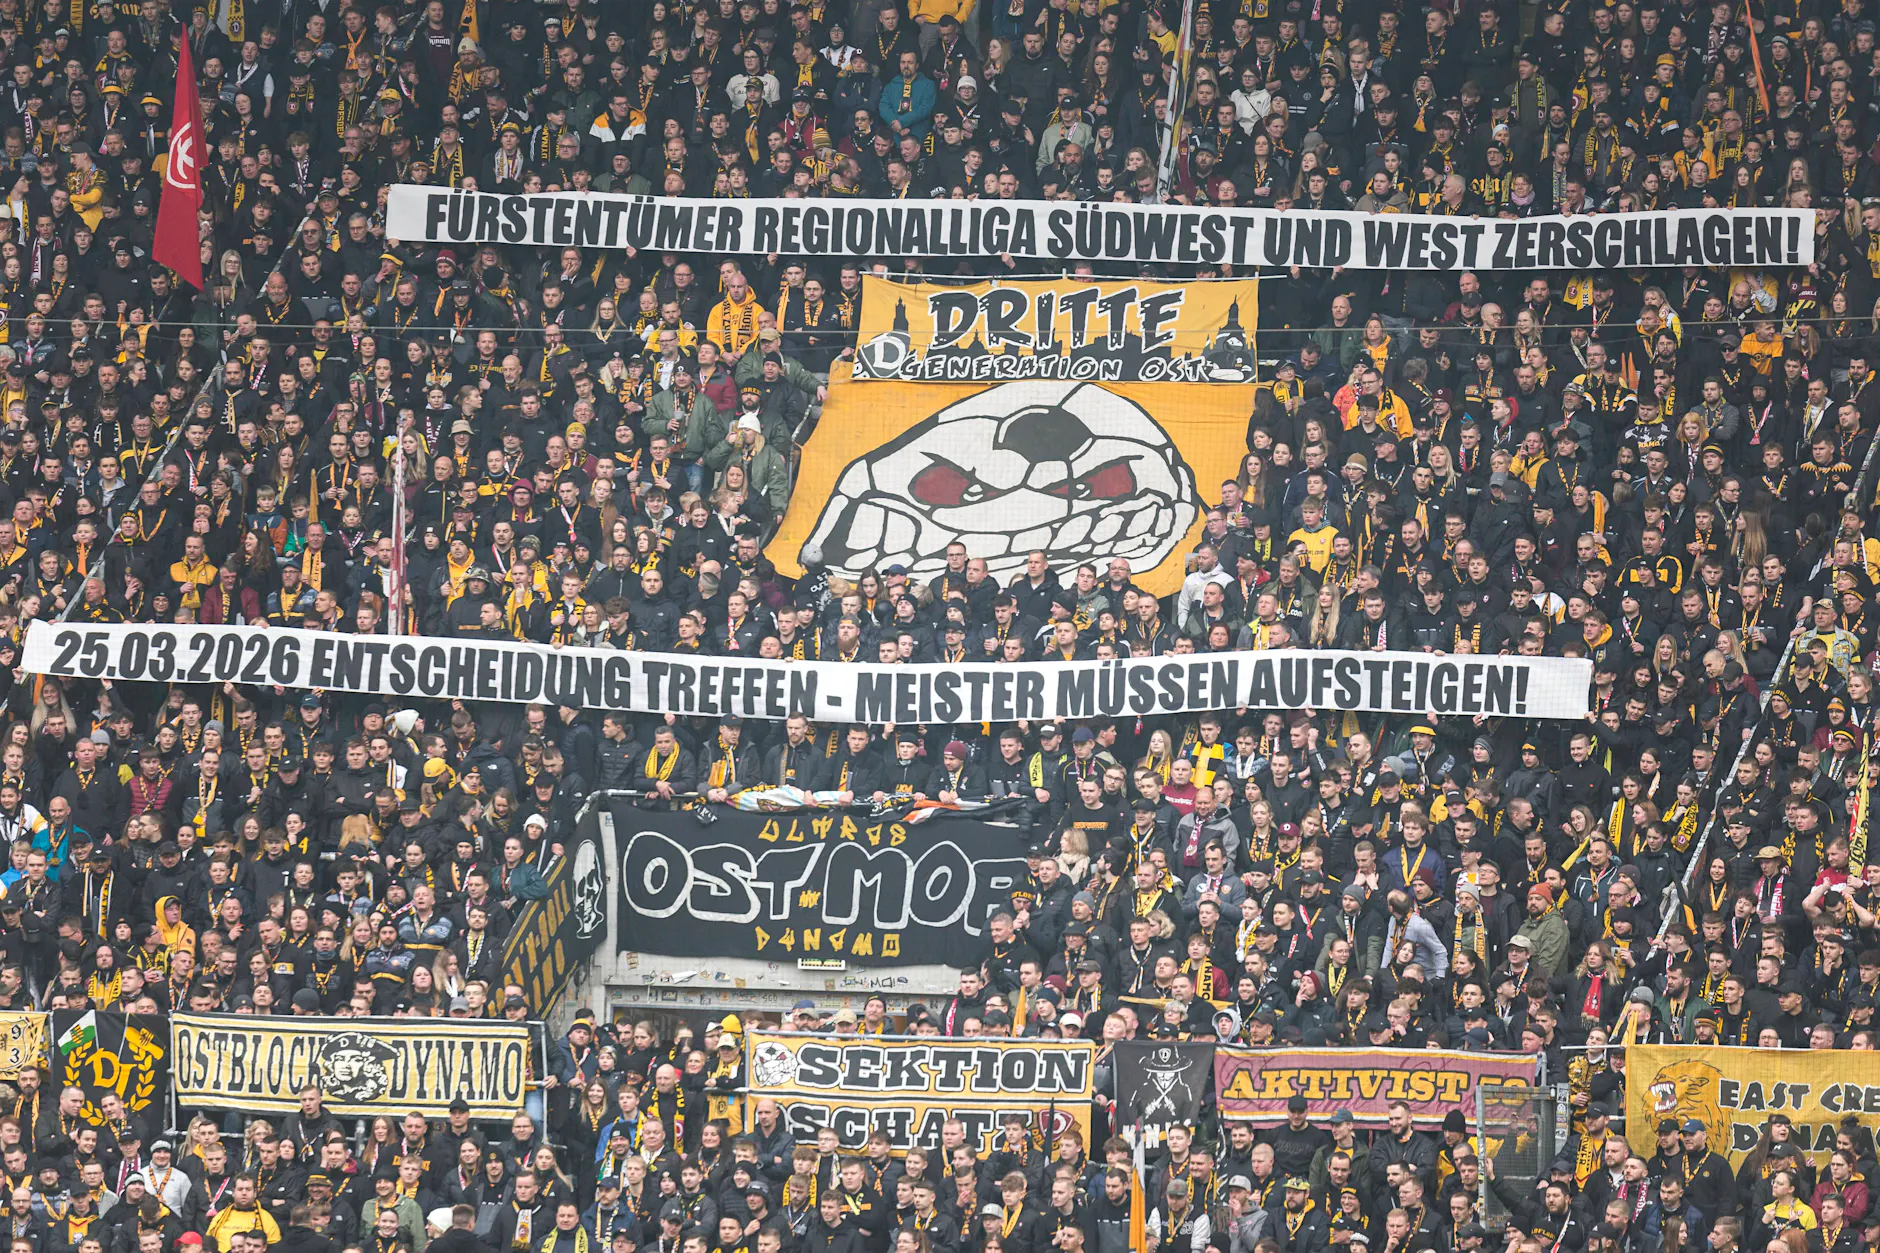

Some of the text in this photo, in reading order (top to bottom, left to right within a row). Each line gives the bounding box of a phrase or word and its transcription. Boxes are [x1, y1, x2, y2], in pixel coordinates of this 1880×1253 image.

[426, 189, 1801, 270] FÜRSTENTÜMER REGIONALLIGA SÜDWEST UND WEST ZERSCHLAGEN!
[928, 286, 1185, 354] DRITTE
[899, 354, 1210, 383] GENERATION OST
[49, 630, 300, 685] 25.03.2026
[308, 638, 631, 709] ENTSCHEIDUNG
[643, 660, 818, 720] TREFFEN
[855, 671, 1044, 723] MEISTER
[1057, 658, 1239, 717] MÜSSEN
[1248, 657, 1530, 715] AUFSTEIGEN!
[177, 1026, 525, 1103] OSTBLOCK DYNAMO
[795, 1042, 1092, 1094] SEKTION
[1222, 1067, 1471, 1104] AKTIVIST
[1719, 1078, 1810, 1112] EAST
